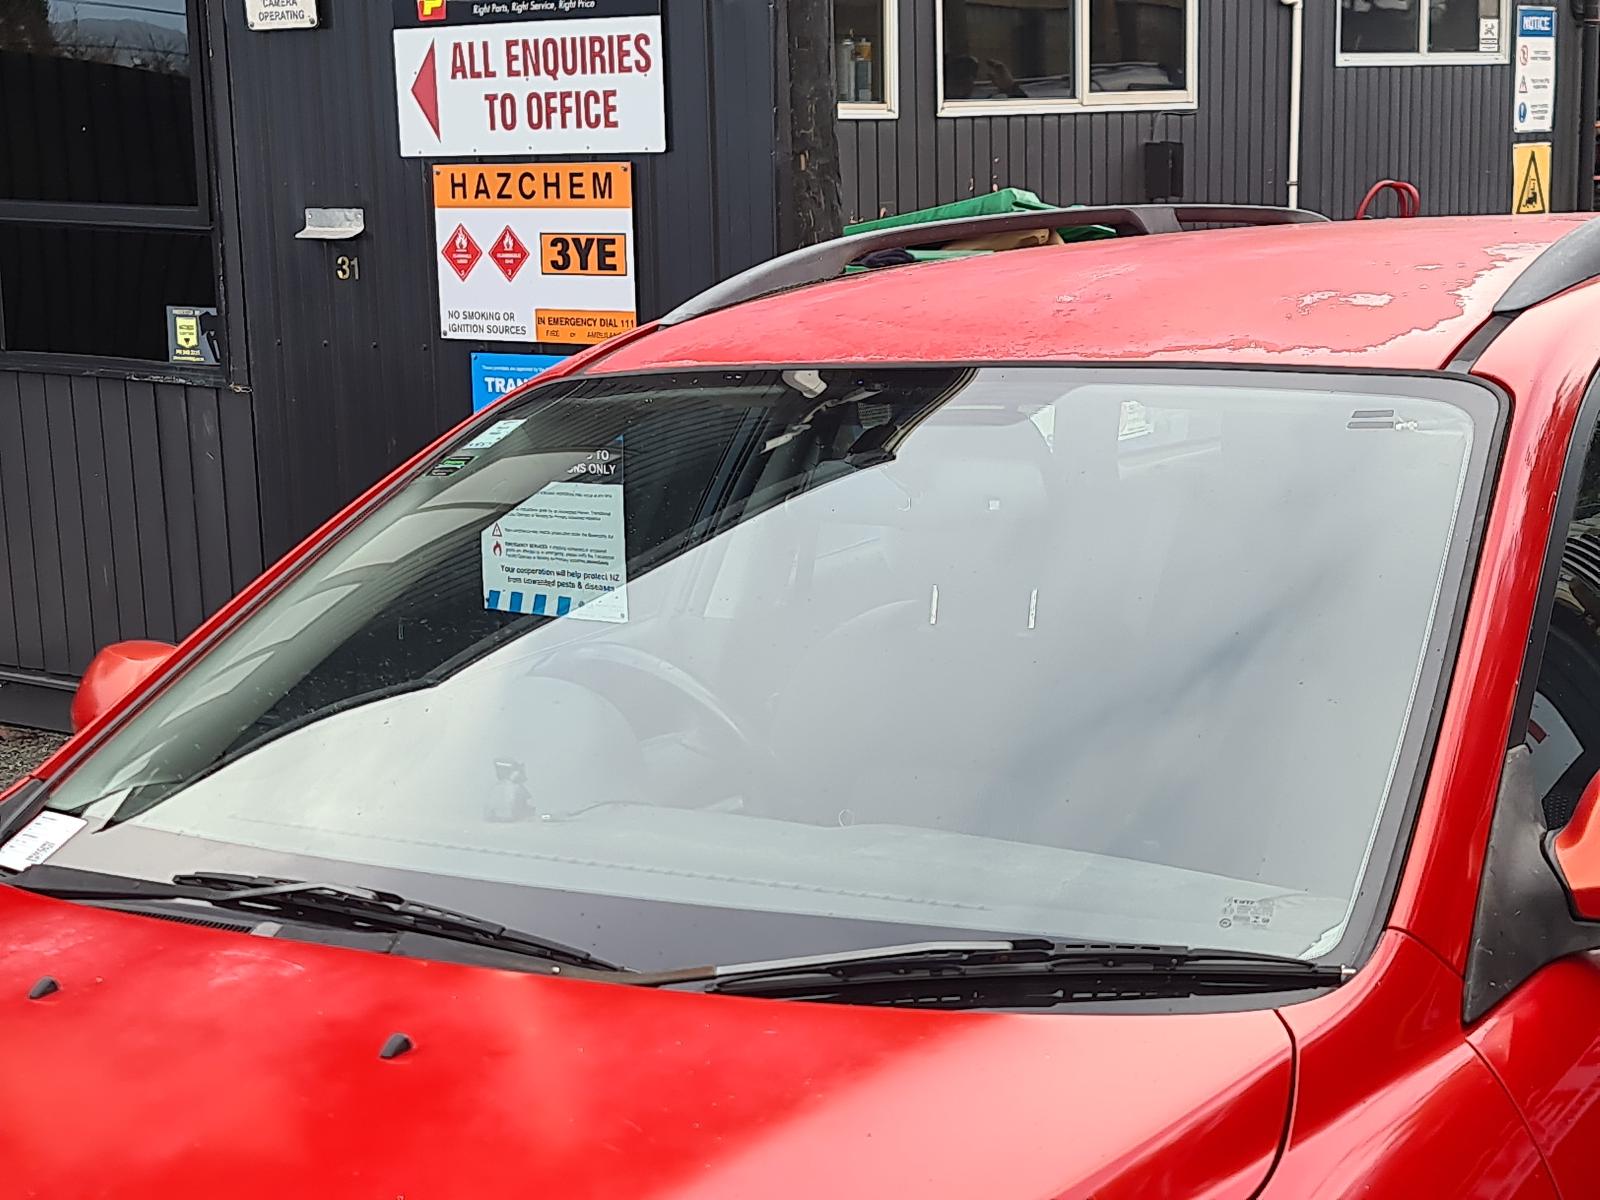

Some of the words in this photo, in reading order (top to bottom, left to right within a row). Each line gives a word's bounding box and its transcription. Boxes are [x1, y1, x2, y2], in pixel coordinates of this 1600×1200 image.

[258, 10, 305, 22] OPERATING
[473, 4, 490, 16] Right
[491, 3, 510, 14] Parts,
[511, 2, 529, 14] Right
[530, 1, 557, 12] Service,
[558, 0, 576, 11] Right
[577, 0, 596, 8] Price
[450, 40, 497, 80] ALL
[505, 33, 651, 81] ENQUIRIES
[484, 92, 517, 131] TO
[526, 89, 619, 131] OFFICE
[450, 171, 613, 200] HAZCHEM
[549, 237, 617, 271] 3YE
[336, 255, 360, 280] 31
[448, 310, 460, 320] NO
[462, 310, 501, 321] SMOKING
[503, 312, 515, 321] OR
[537, 316, 546, 325] IN
[548, 317, 597, 327] EMERGENCY
[599, 318, 618, 328] DIAL
[620, 319, 634, 328] 111
[448, 323, 484, 333] IGNITION
[486, 324, 527, 335] SOURCES
[588, 463, 616, 476] ONLY
[500, 564, 516, 574] Your
[516, 566, 555, 577] cooperation
[555, 568, 566, 577] will
[566, 569, 582, 580] help
[583, 571, 608, 582] protect
[557, 579, 576, 589] pests
[584, 581, 615, 592] diseases
